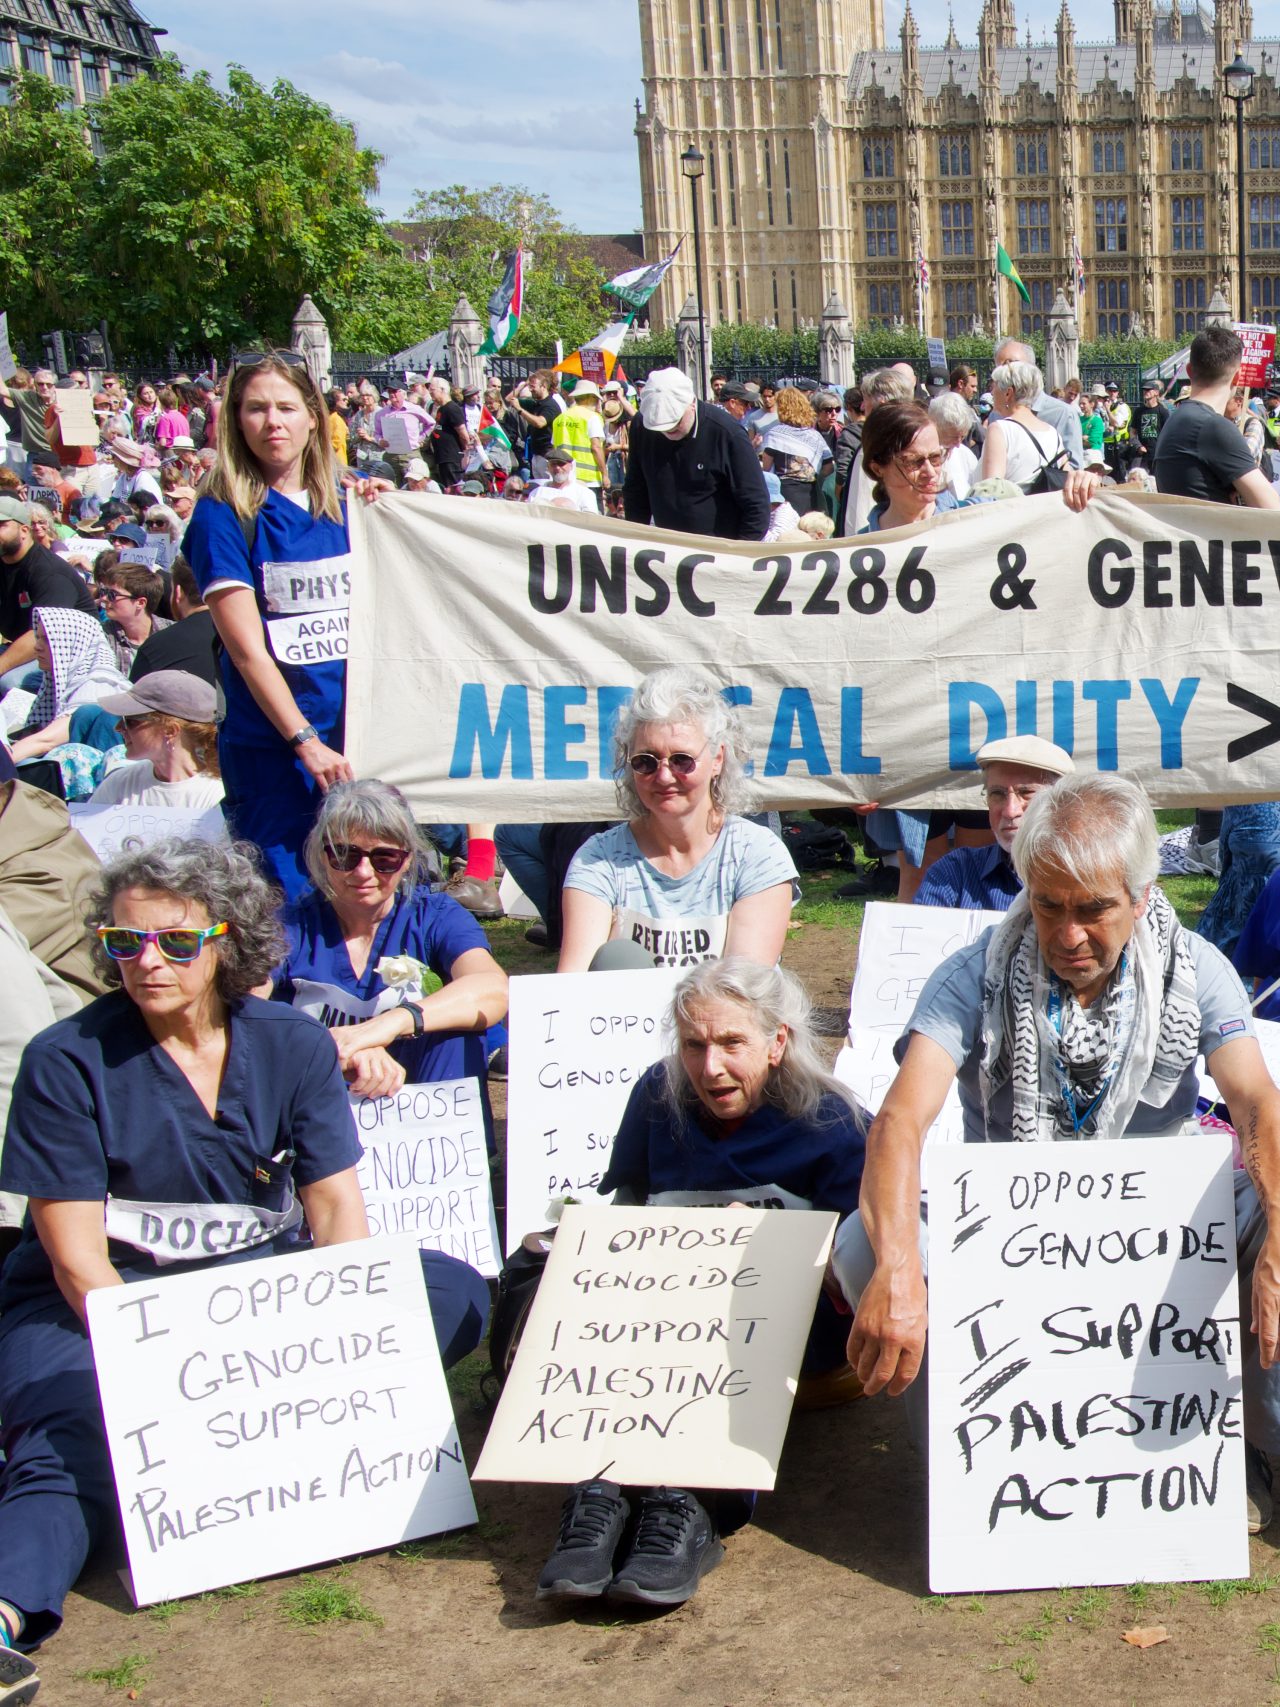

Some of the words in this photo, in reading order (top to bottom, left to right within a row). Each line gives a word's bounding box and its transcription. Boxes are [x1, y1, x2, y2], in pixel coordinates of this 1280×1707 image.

[528, 544, 716, 617] UNSC
[752, 546, 937, 616] 2286
[989, 542, 1038, 611] &
[632, 922, 711, 955] RETIRED
[888, 926, 923, 956] I
[543, 1010, 560, 1043] I
[359, 1086, 471, 1131] OPPOSE
[544, 1129, 558, 1156] I
[954, 1170, 980, 1223] I
[1009, 1171, 1147, 1211] OPPOSE
[577, 1230, 586, 1256] I
[608, 1225, 753, 1253] OPPOSE
[1001, 1222, 1228, 1270] GENOCIDE
[117, 1294, 170, 1343] I
[208, 1260, 391, 1325] OPPOSE
[551, 1320, 562, 1351] I
[579, 1317, 768, 1344] SUPPORT
[954, 1299, 1021, 1385] I
[178, 1325, 401, 1401] GENOCIDE
[124, 1420, 166, 1475] I
[207, 1386, 407, 1449] SUPPORT
[953, 1392, 1242, 1475] PALESTINE
[129, 1476, 328, 1553] PALESTINE
[340, 1442, 463, 1499] ACTION
[988, 1441, 1226, 1534] ACTION
